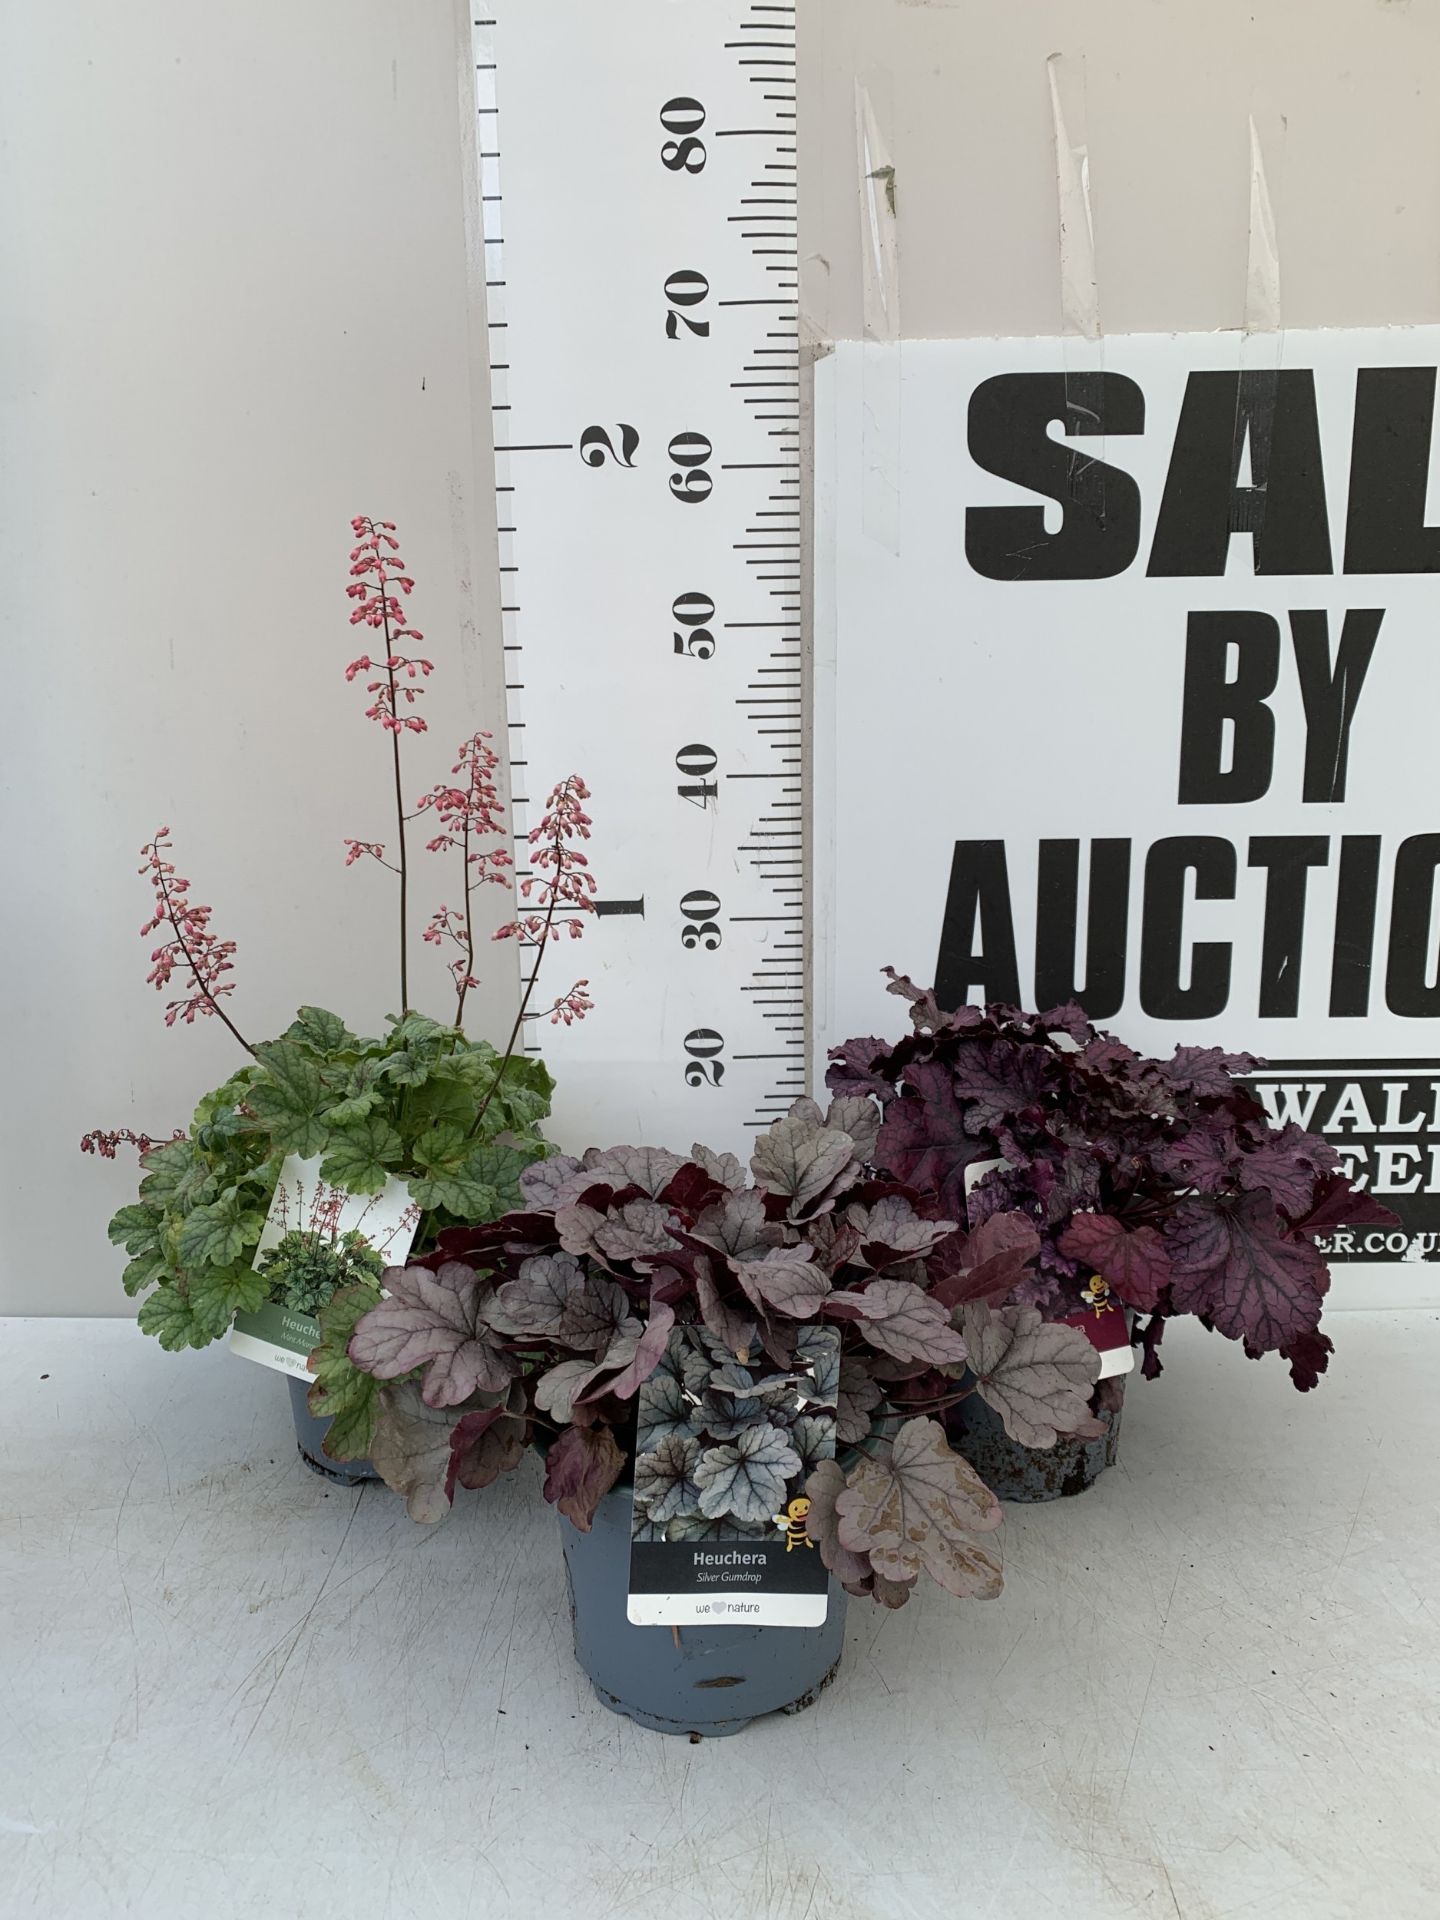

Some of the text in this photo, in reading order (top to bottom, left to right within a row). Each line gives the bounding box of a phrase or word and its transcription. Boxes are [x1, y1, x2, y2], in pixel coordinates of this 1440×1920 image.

[659, 96, 707, 175] 80
[663, 269, 710, 340] 70
[579, 423, 640, 468] 2
[667, 431, 713, 504] 60
[964, 366, 1440, 582] SAL
[671, 591, 716, 660] 50
[1177, 608, 1387, 805] BY
[675, 743, 718, 810] 40
[679, 889, 722, 951] 30
[683, 1028, 725, 1088] 20
[1255, 1083, 1440, 1134] WAL
[693, 1551, 767, 1566] Heuchera
[696, 1571, 762, 1585] Silver Gumdrop
[695, 1602, 760, 1614] we nature
